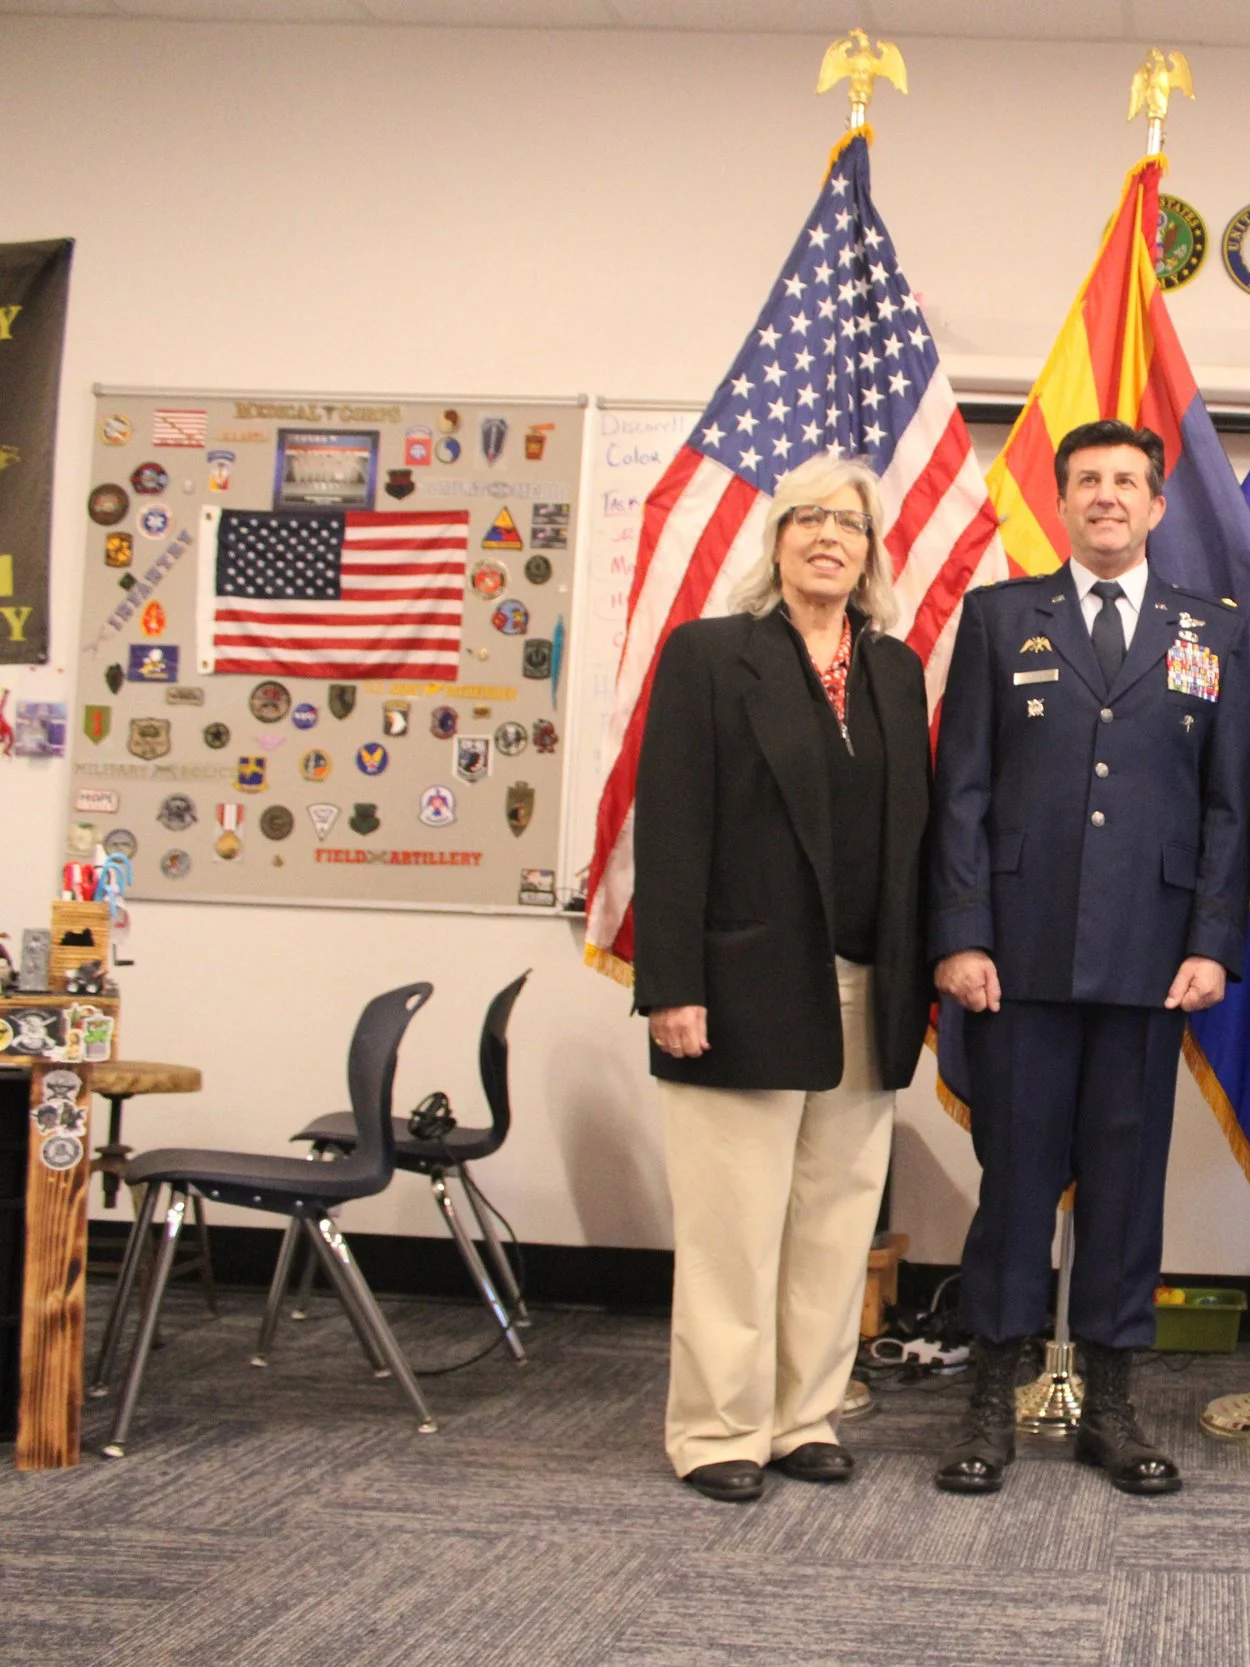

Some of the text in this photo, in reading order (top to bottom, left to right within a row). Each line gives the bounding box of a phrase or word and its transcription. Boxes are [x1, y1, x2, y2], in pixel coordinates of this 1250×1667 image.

[105, 528, 197, 633] INFANTRY
[314, 848, 483, 866] FIELD ARTILLERY
